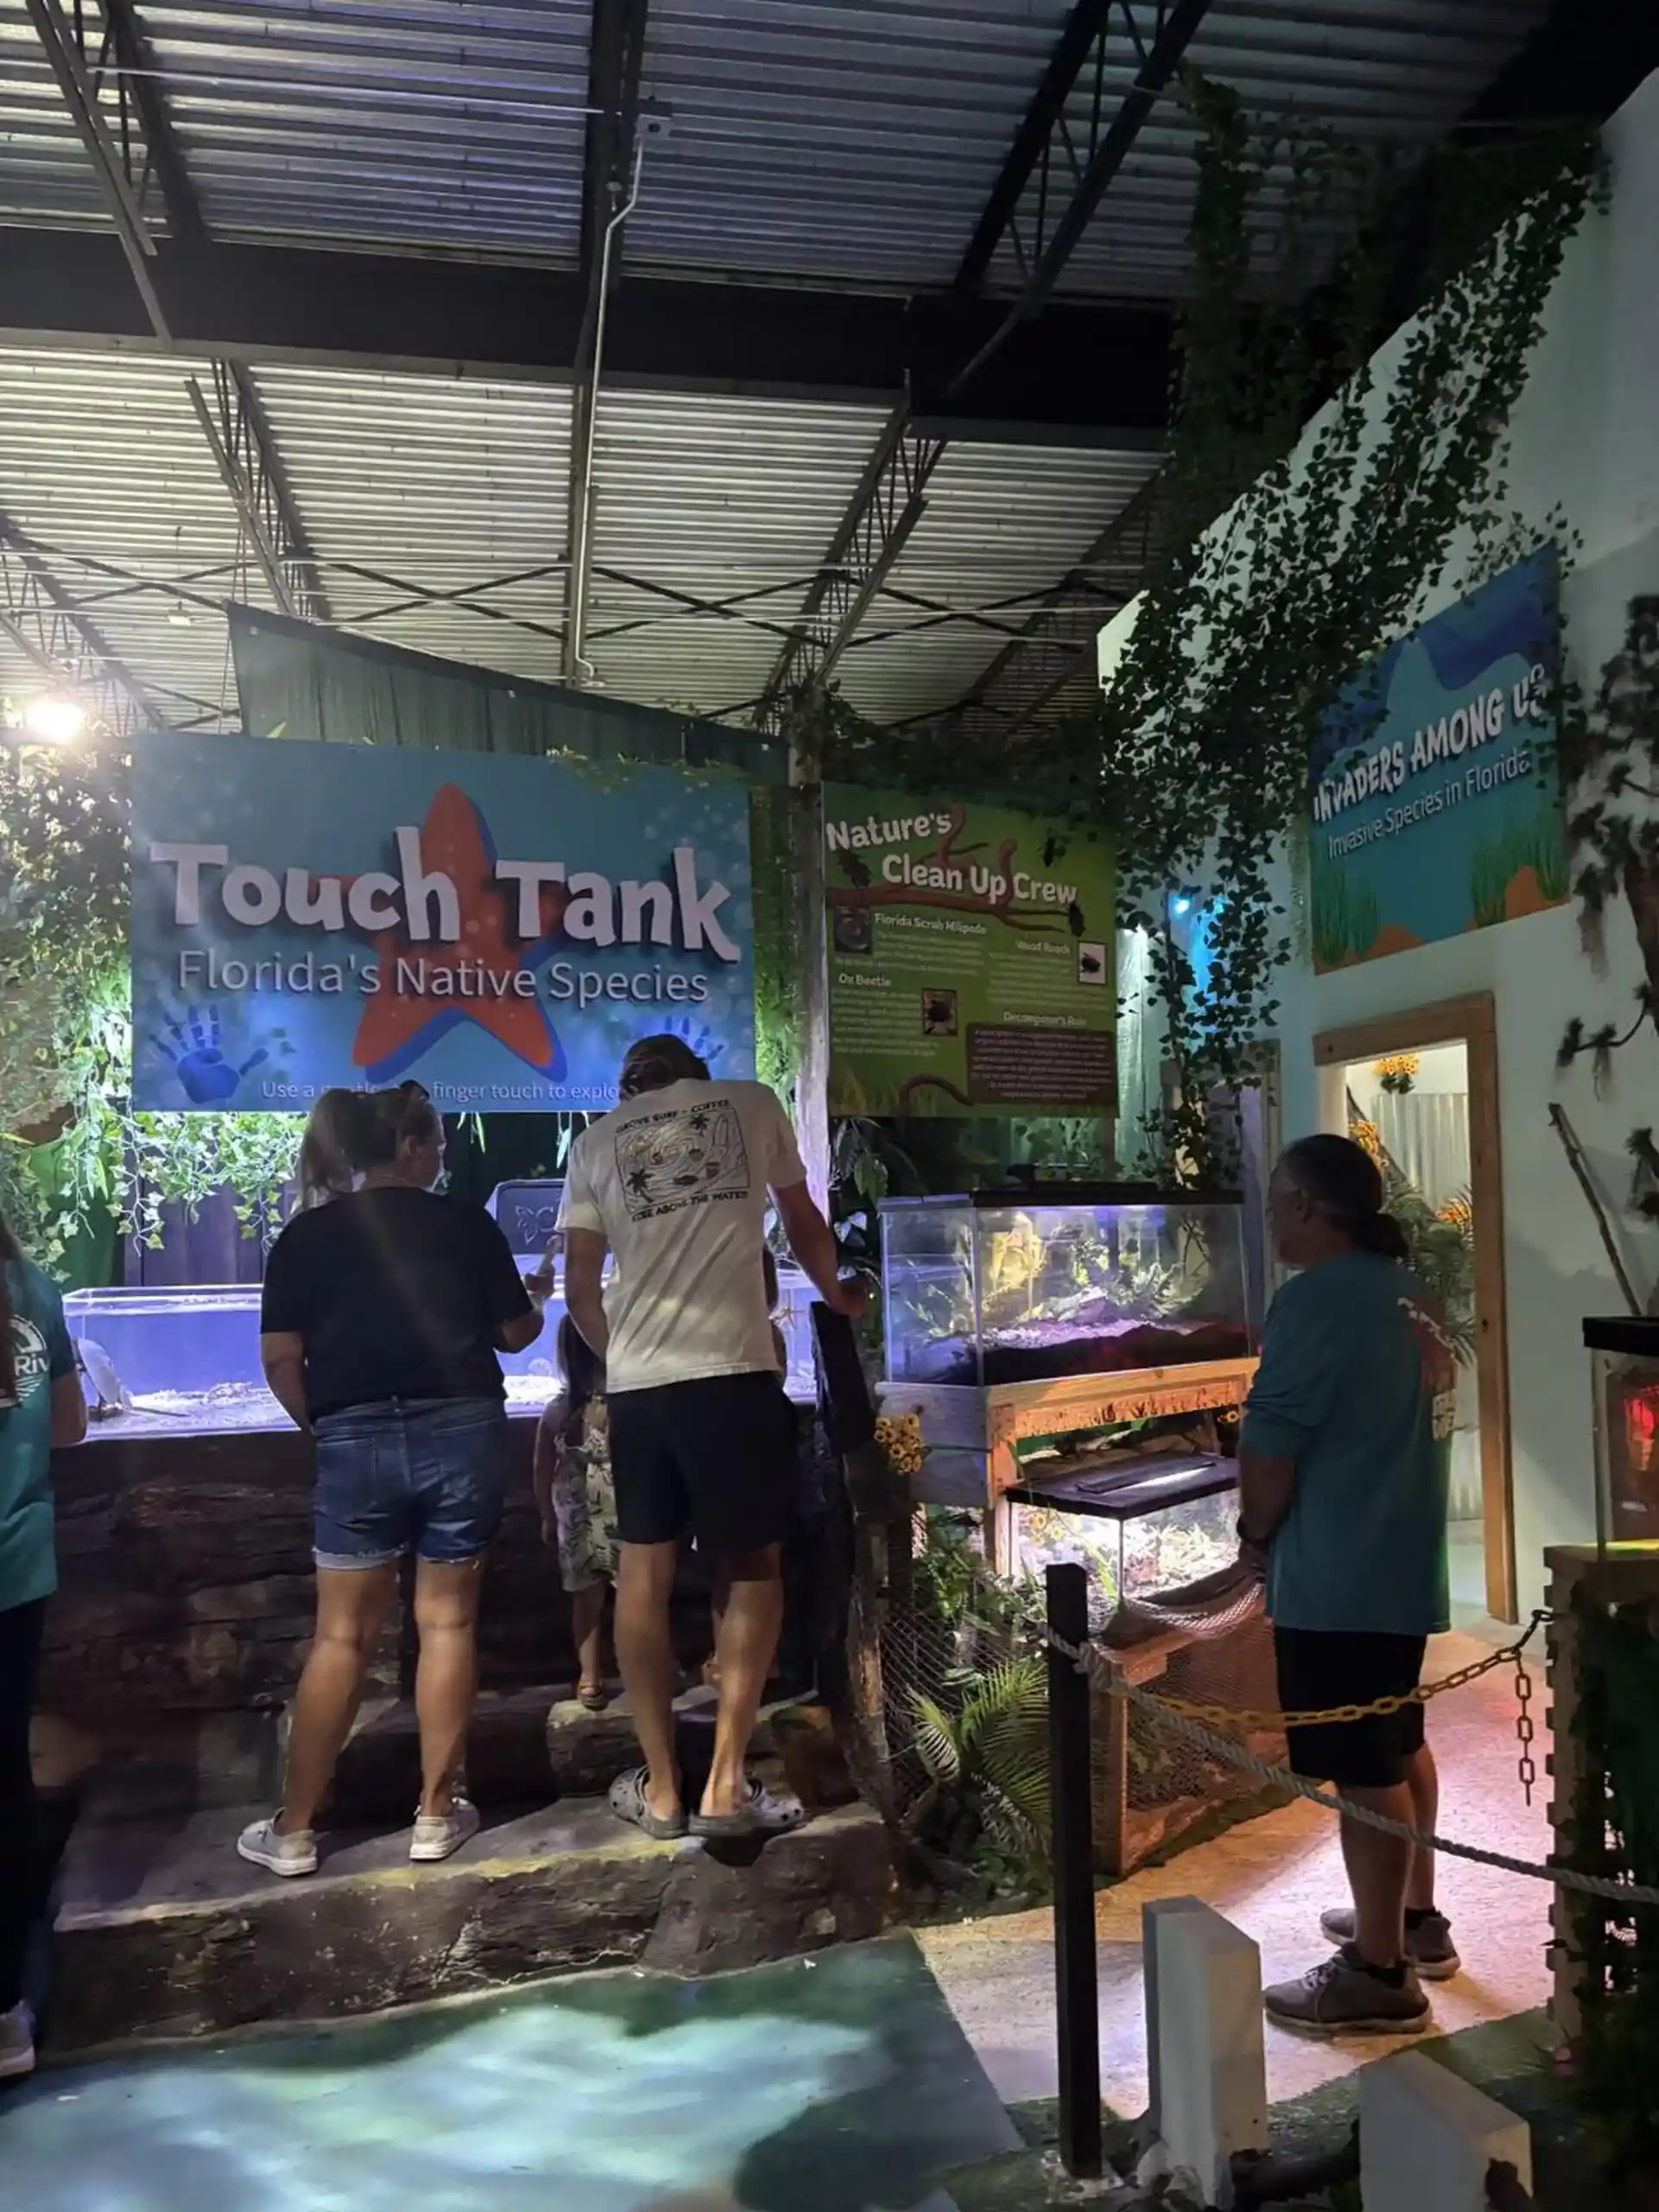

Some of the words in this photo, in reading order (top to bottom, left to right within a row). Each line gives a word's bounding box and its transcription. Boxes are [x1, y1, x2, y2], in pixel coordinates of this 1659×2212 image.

[1313, 741, 1405, 822] INVADERS
[1411, 688, 1505, 772] AMONG
[1329, 817, 1383, 860] Invasive
[1385, 790, 1443, 836] Species
[1446, 779, 1462, 807] in
[1465, 747, 1531, 803] Florida
[826, 812, 952, 850] Nature's
[149, 825, 461, 940] Touch
[496, 847, 741, 961] Tank
[882, 854, 963, 893] Clean
[970, 867, 1007, 904] Up
[1014, 872, 1077, 904] Crew
[874, 912, 912, 927] Florida
[177, 949, 380, 994] Florida's
[396, 957, 537, 998] Native
[550, 960, 709, 1002] Species
[856, 974, 892, 987] Beetle
[263, 1081, 298, 1098] Use
[303, 1085, 315, 1098] a
[432, 1081, 486, 1103] finger
[492, 1082, 543, 1100] touch
[549, 1084, 567, 1101] to
[570, 1082, 620, 1103] explo
[14, 1353, 48, 1376] Riv
